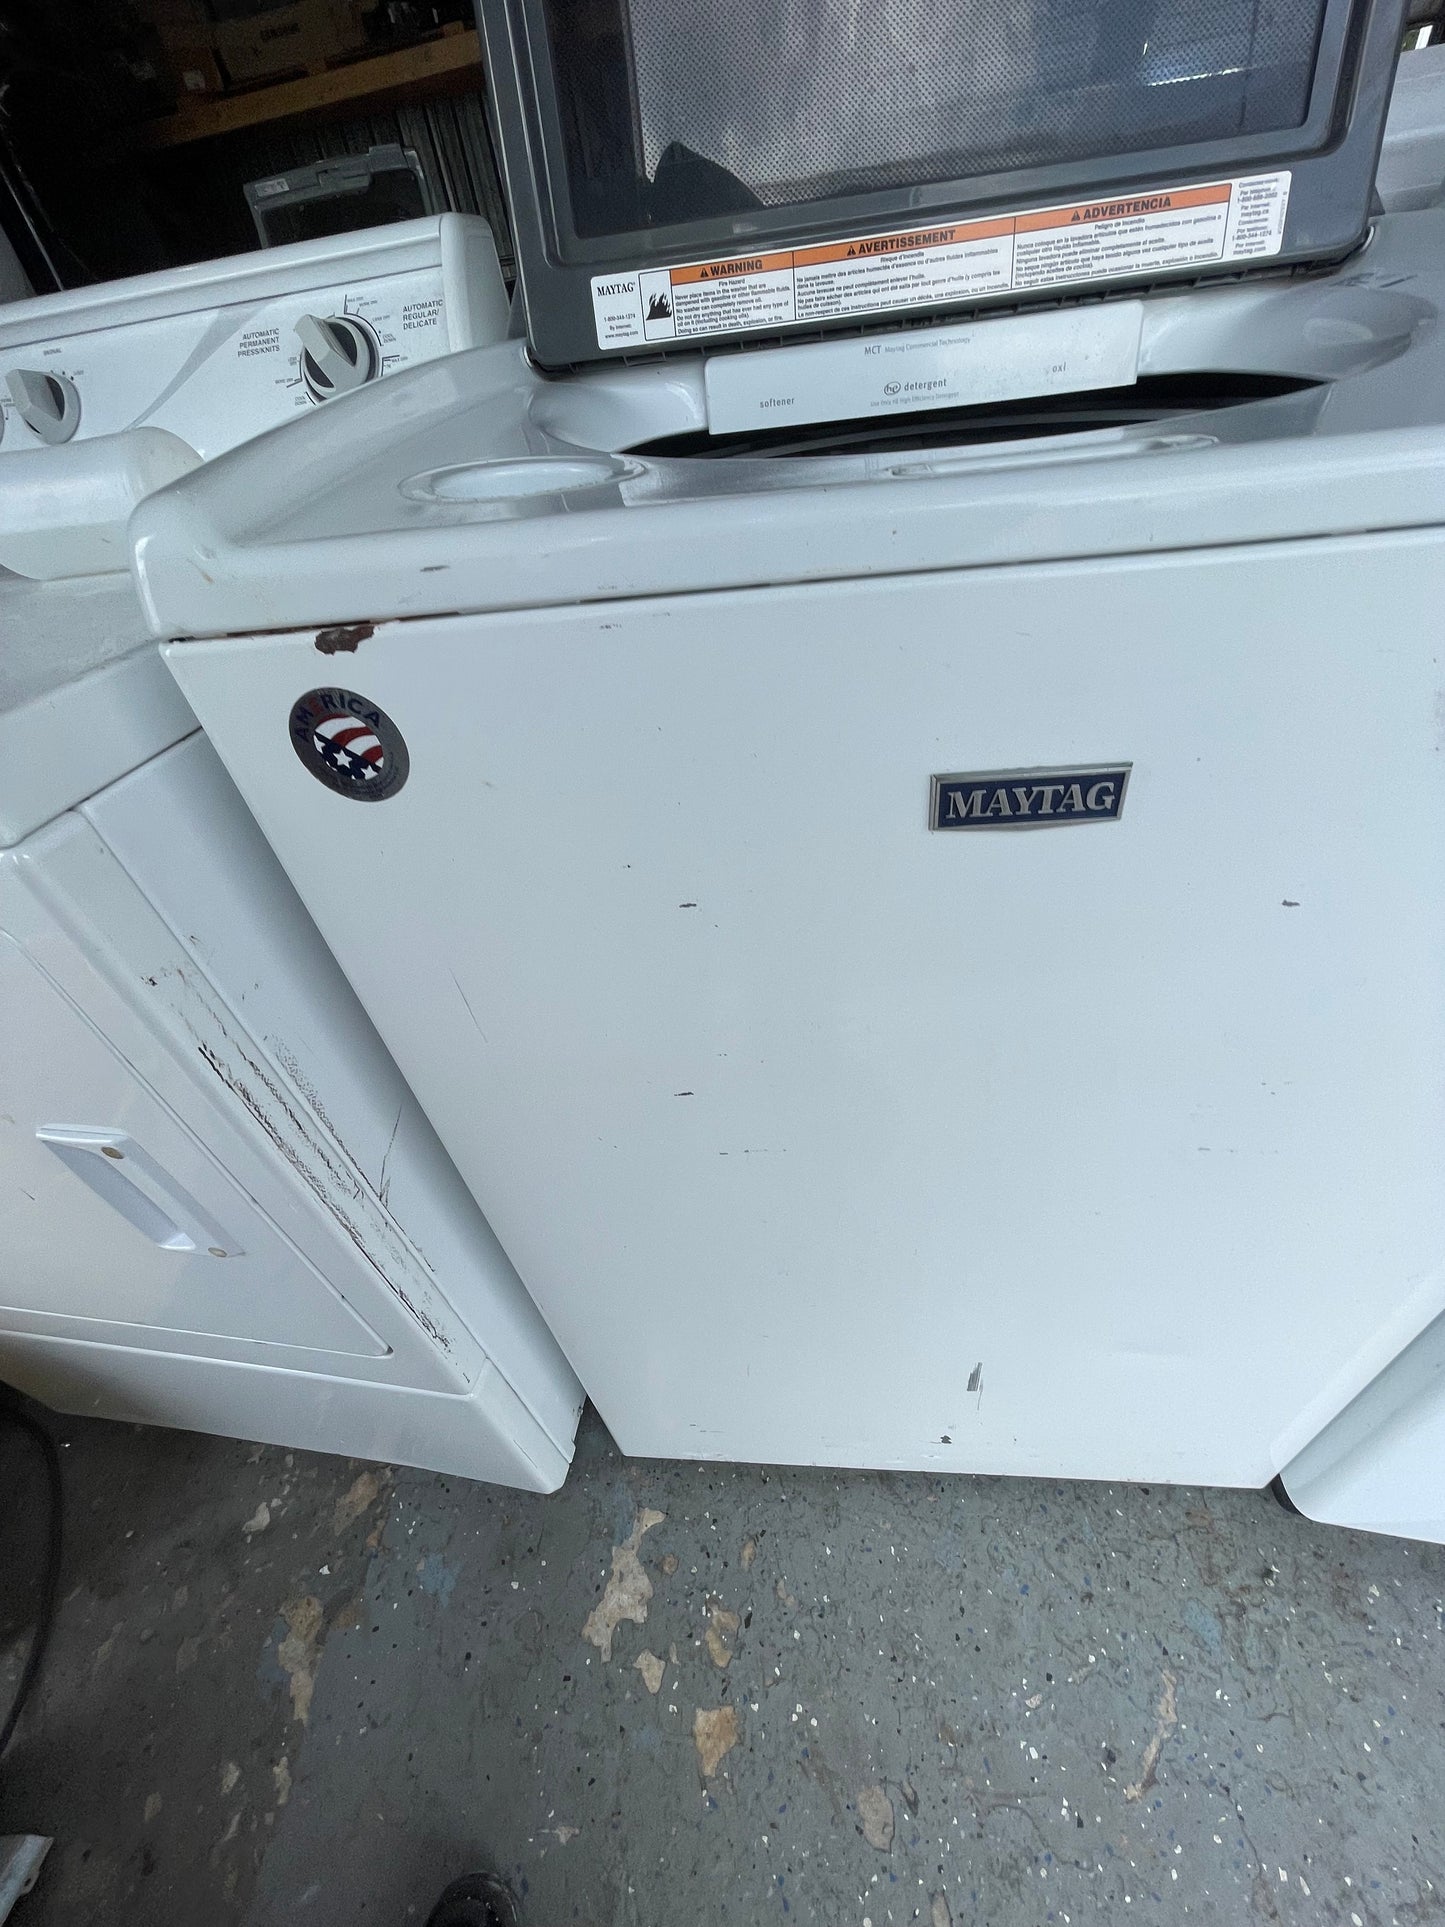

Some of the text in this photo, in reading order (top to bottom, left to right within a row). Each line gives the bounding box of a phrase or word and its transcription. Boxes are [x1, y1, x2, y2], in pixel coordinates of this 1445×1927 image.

[1083, 196, 1171, 220] ADVERTENCIA
[858, 230, 956, 254] AVERTISSEMENT
[711, 259, 763, 276] WARNING
[403, 300, 443, 312] AUTOMATIC
[403, 309, 439, 321] REGULAR/
[403, 318, 437, 330] DELICATE
[243, 328, 279, 340] AUTOMATIC
[240, 337, 279, 349] PERMANENT
[238, 345, 280, 357] PRESS/KNITS
[864, 344, 881, 355] MCT
[904, 378, 947, 391] detergent
[759, 398, 795, 408] softener
[945, 781, 1116, 819] MAYTAG
